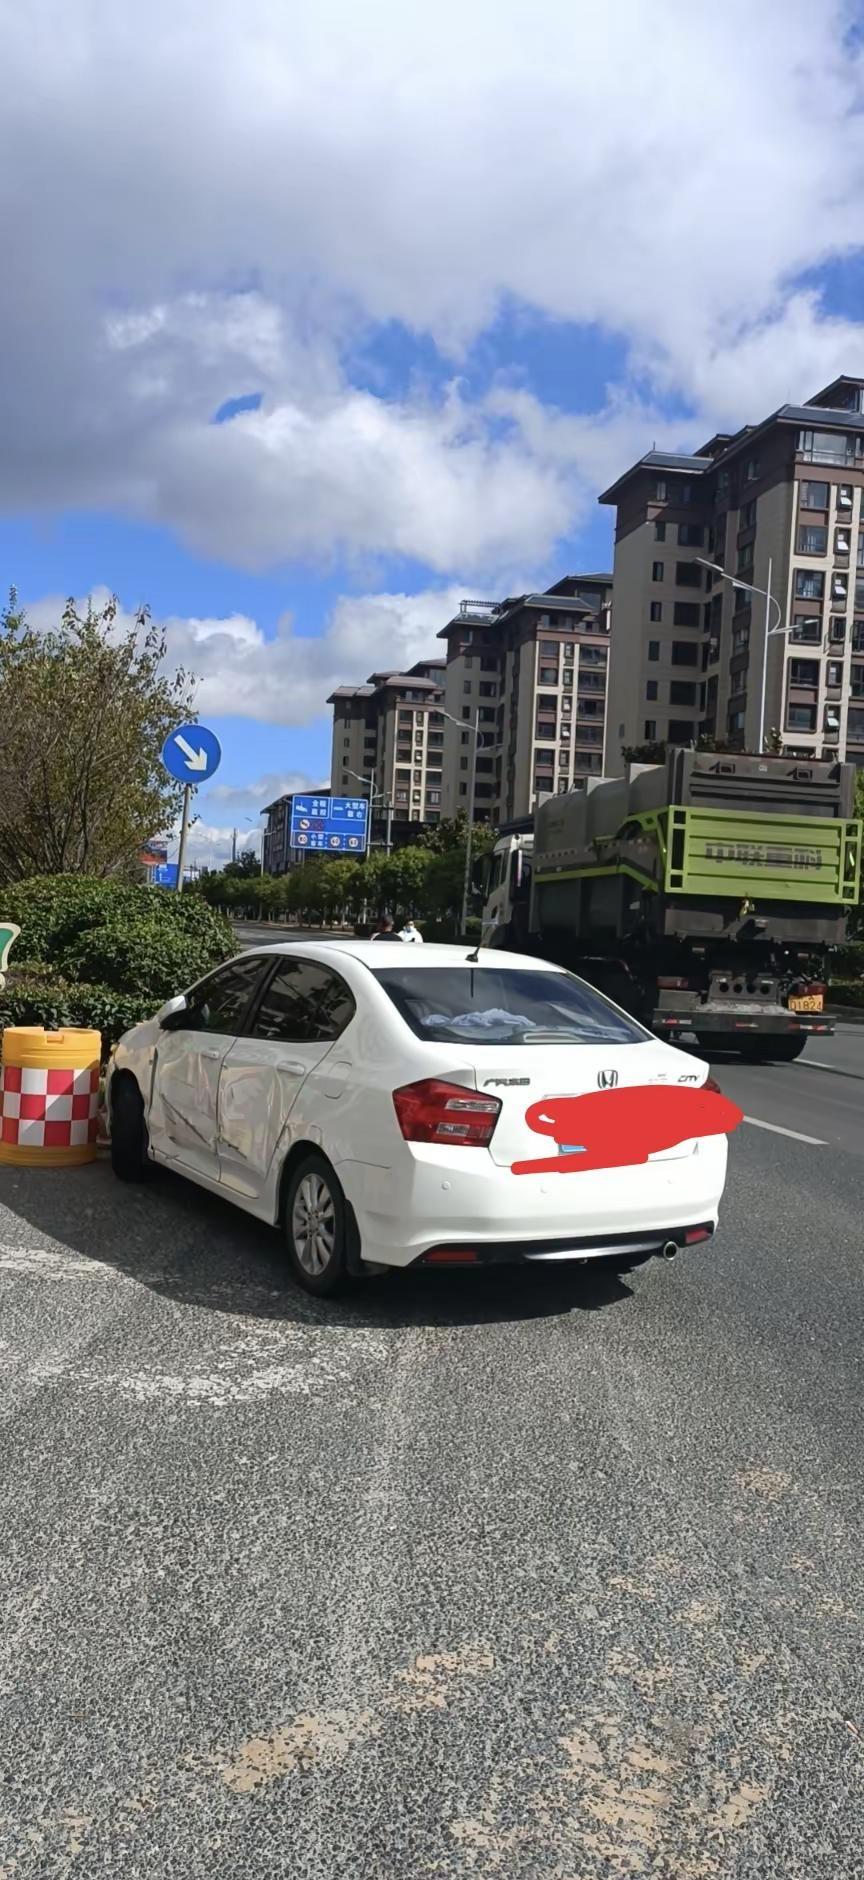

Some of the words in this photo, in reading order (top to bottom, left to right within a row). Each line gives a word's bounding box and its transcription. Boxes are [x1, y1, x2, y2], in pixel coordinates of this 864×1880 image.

[345, 802, 365, 810] 大型车
[705, 842, 822, 870] 中联重科
